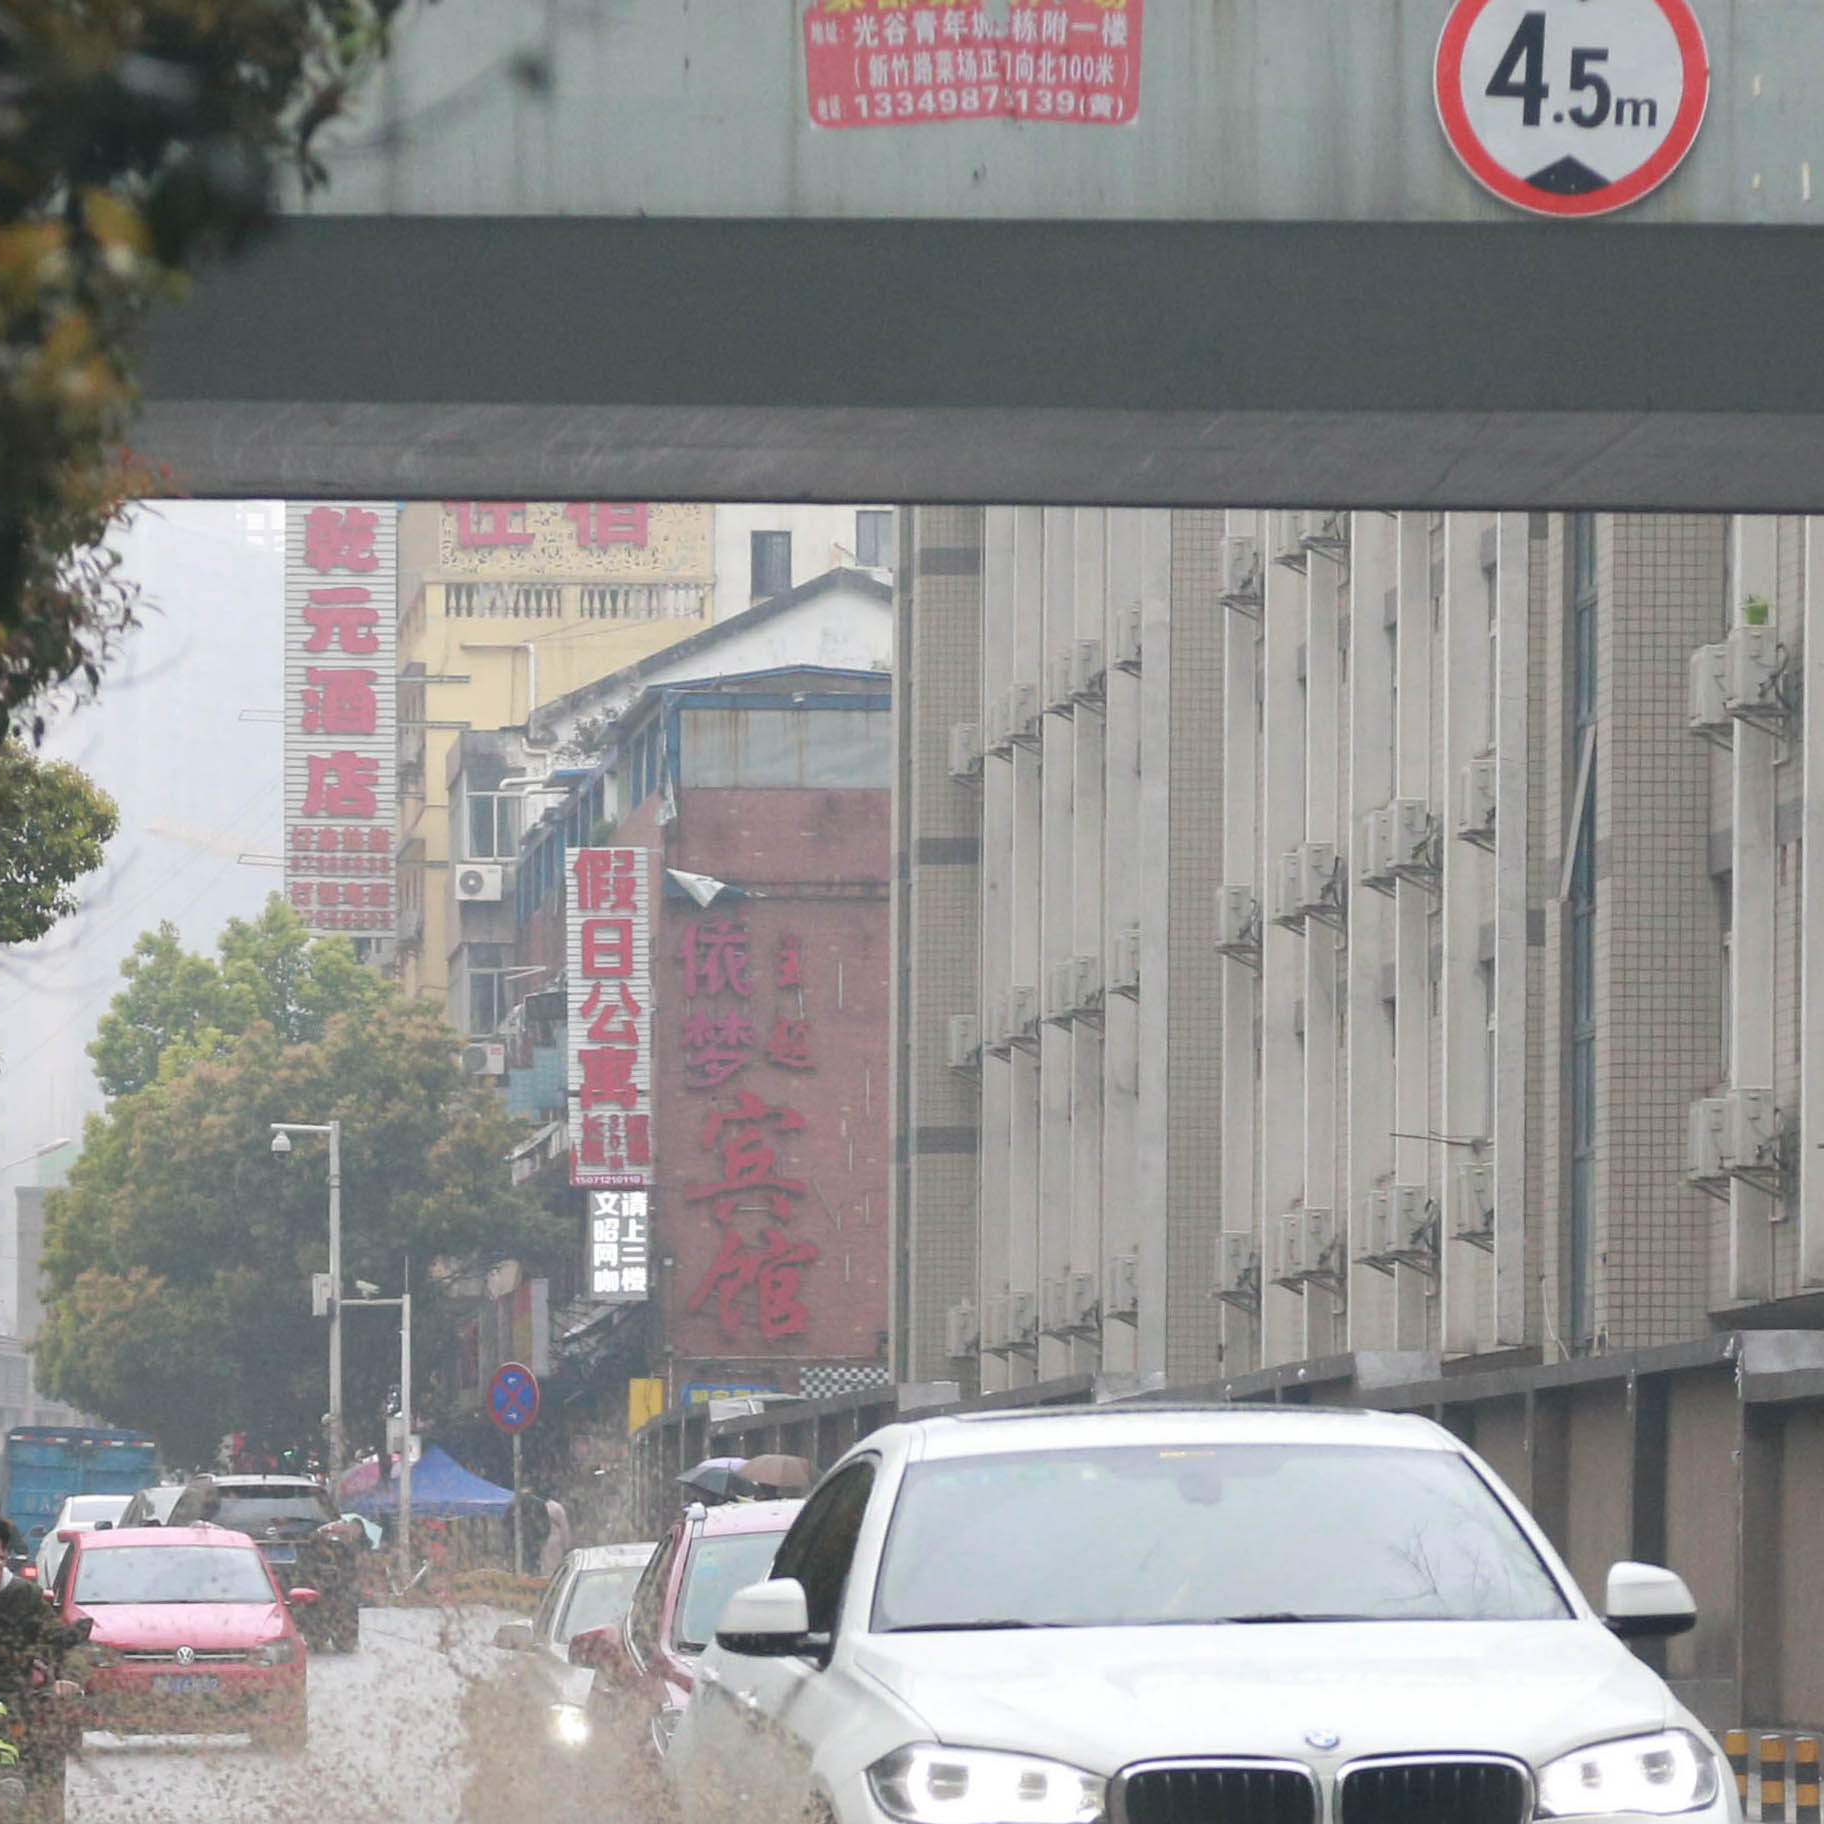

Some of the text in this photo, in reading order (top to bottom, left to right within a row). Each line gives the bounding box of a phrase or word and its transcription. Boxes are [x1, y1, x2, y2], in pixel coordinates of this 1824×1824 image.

[1484, 10, 1658, 128] 4.5m
[301, 506, 380, 818] 乾元酒店
[574, 849, 642, 1109] 假日公寓
[593, 1191, 620, 1293] 文昭网咖
[621, 1191, 648, 1292] 请上二楼
